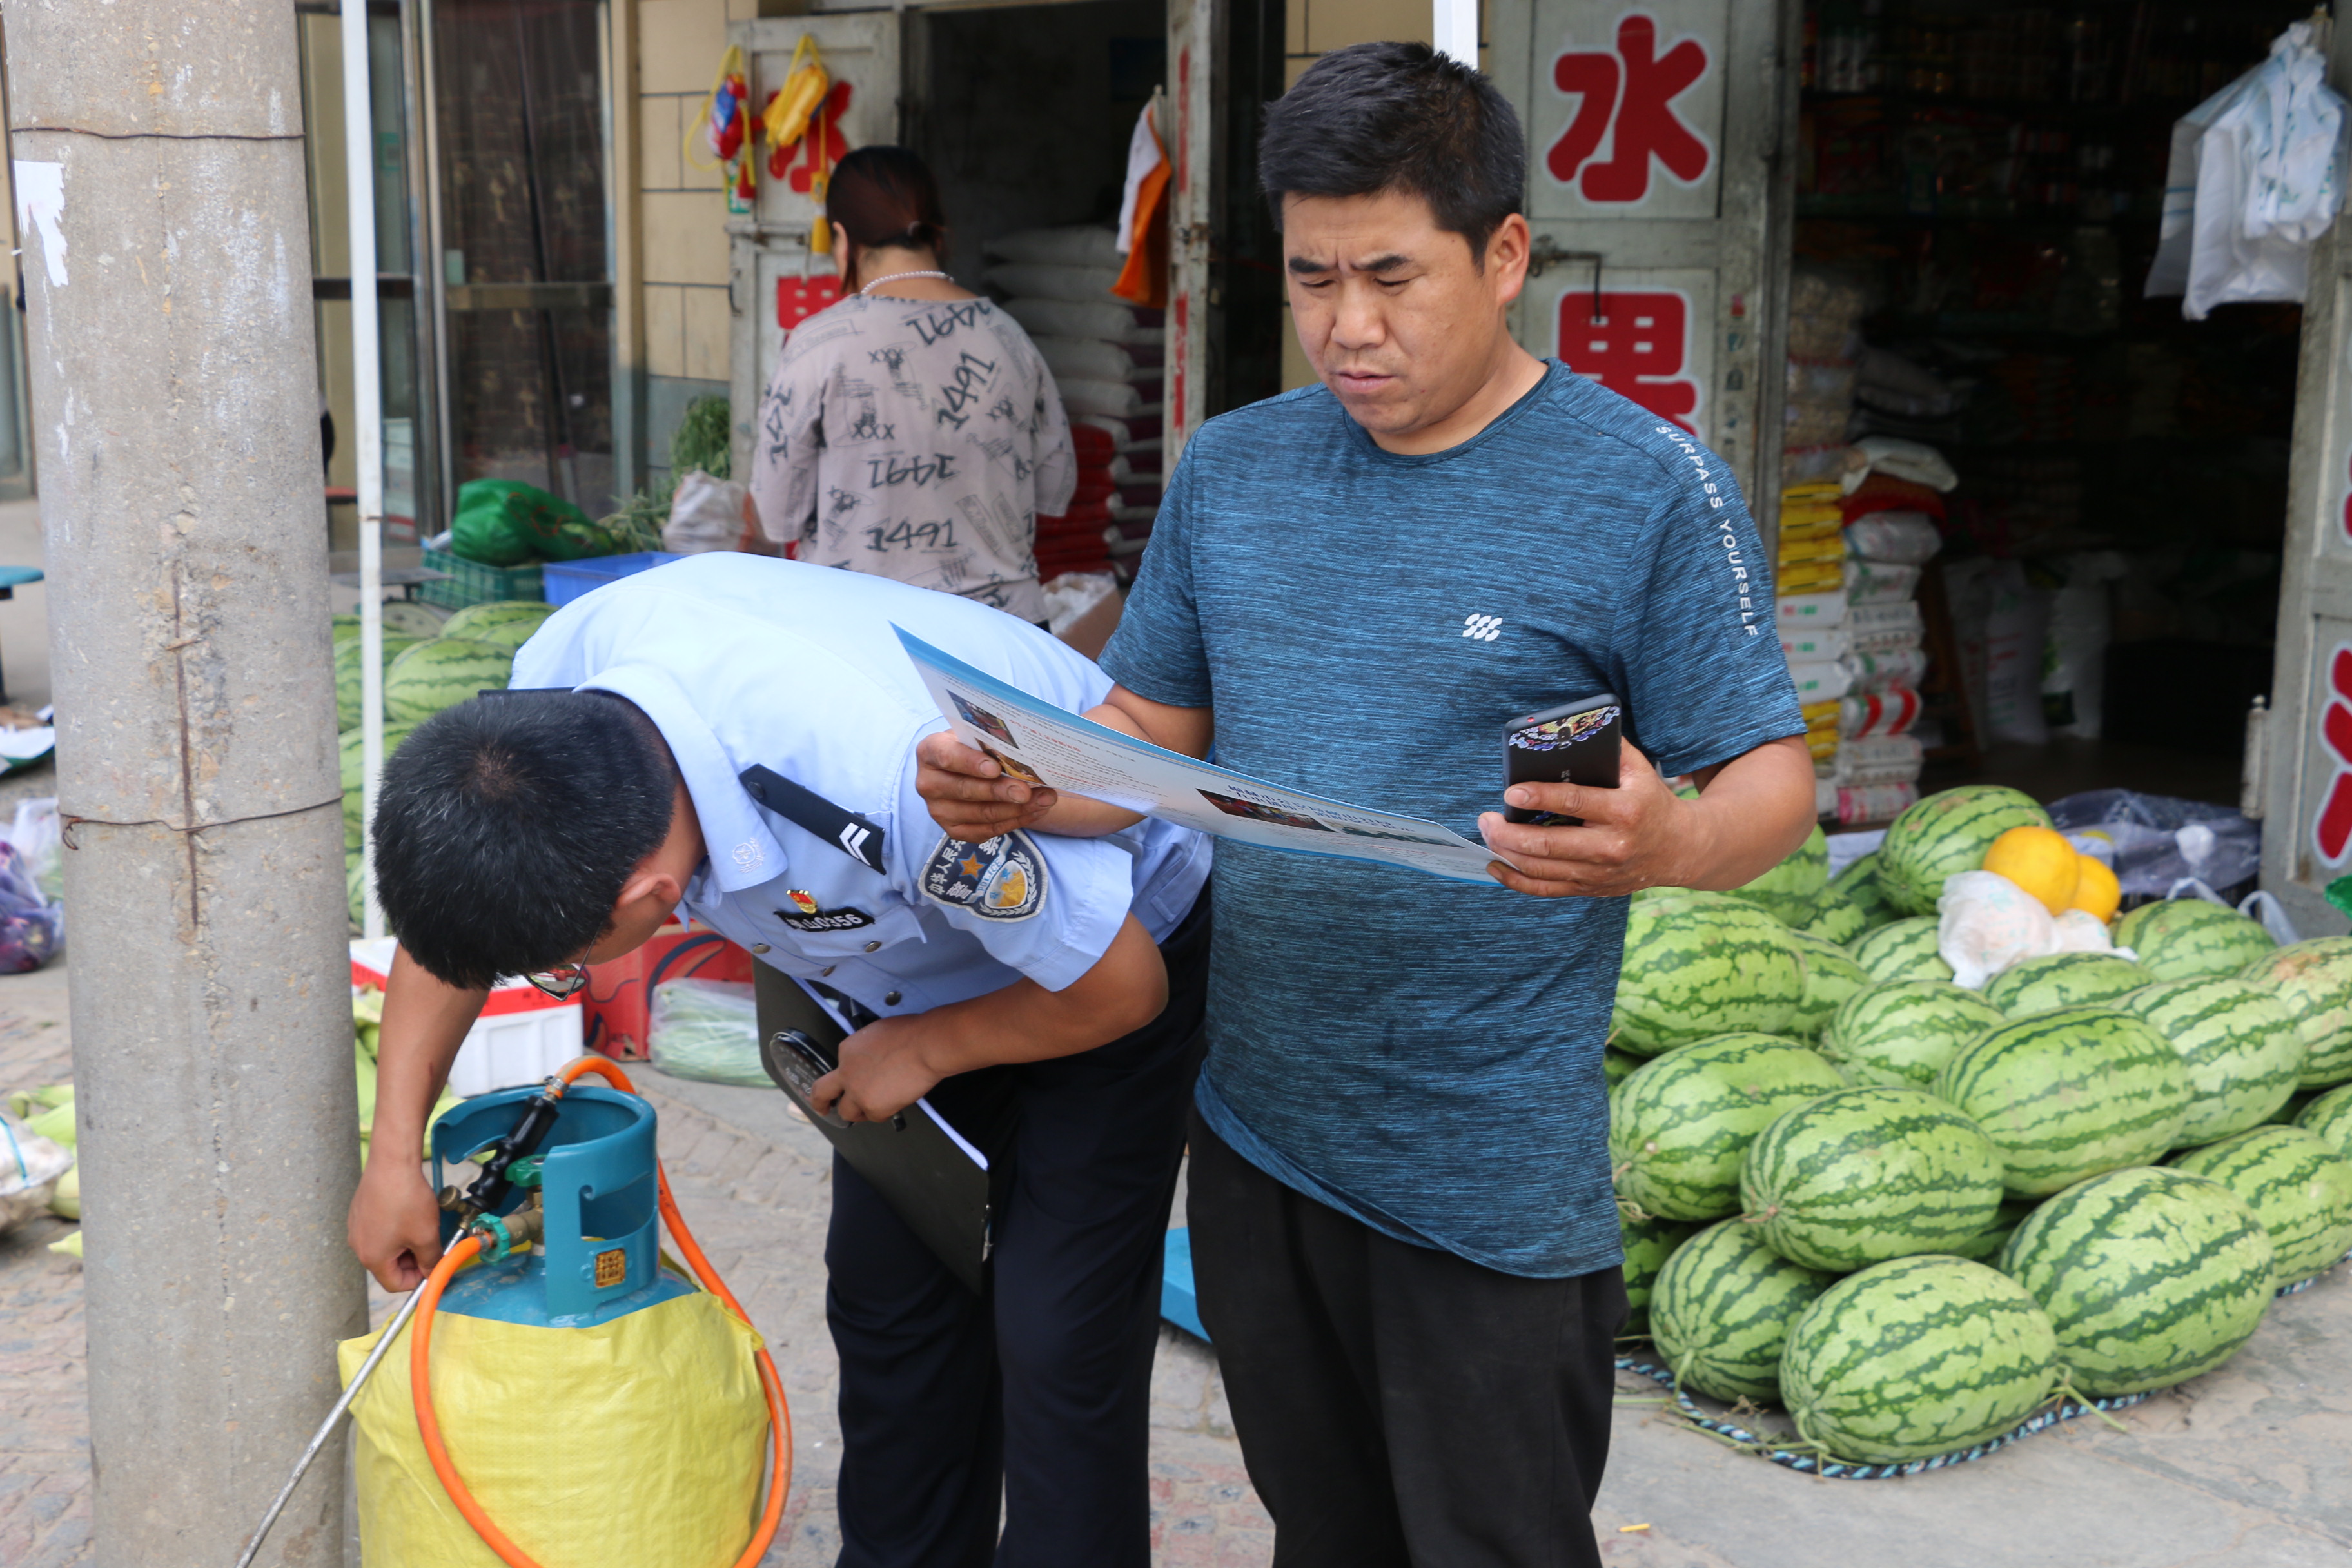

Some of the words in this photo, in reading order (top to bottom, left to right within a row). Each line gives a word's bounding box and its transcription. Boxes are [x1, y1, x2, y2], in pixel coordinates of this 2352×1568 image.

[936, 351, 995, 431] 1491
[867, 453, 958, 489] 1491
[865, 518, 961, 553] 1491
[1656, 426, 1723, 509] SURPASS
[1720, 519, 1759, 636] YOURSELF
[977, 858, 1001, 892] POLICE
